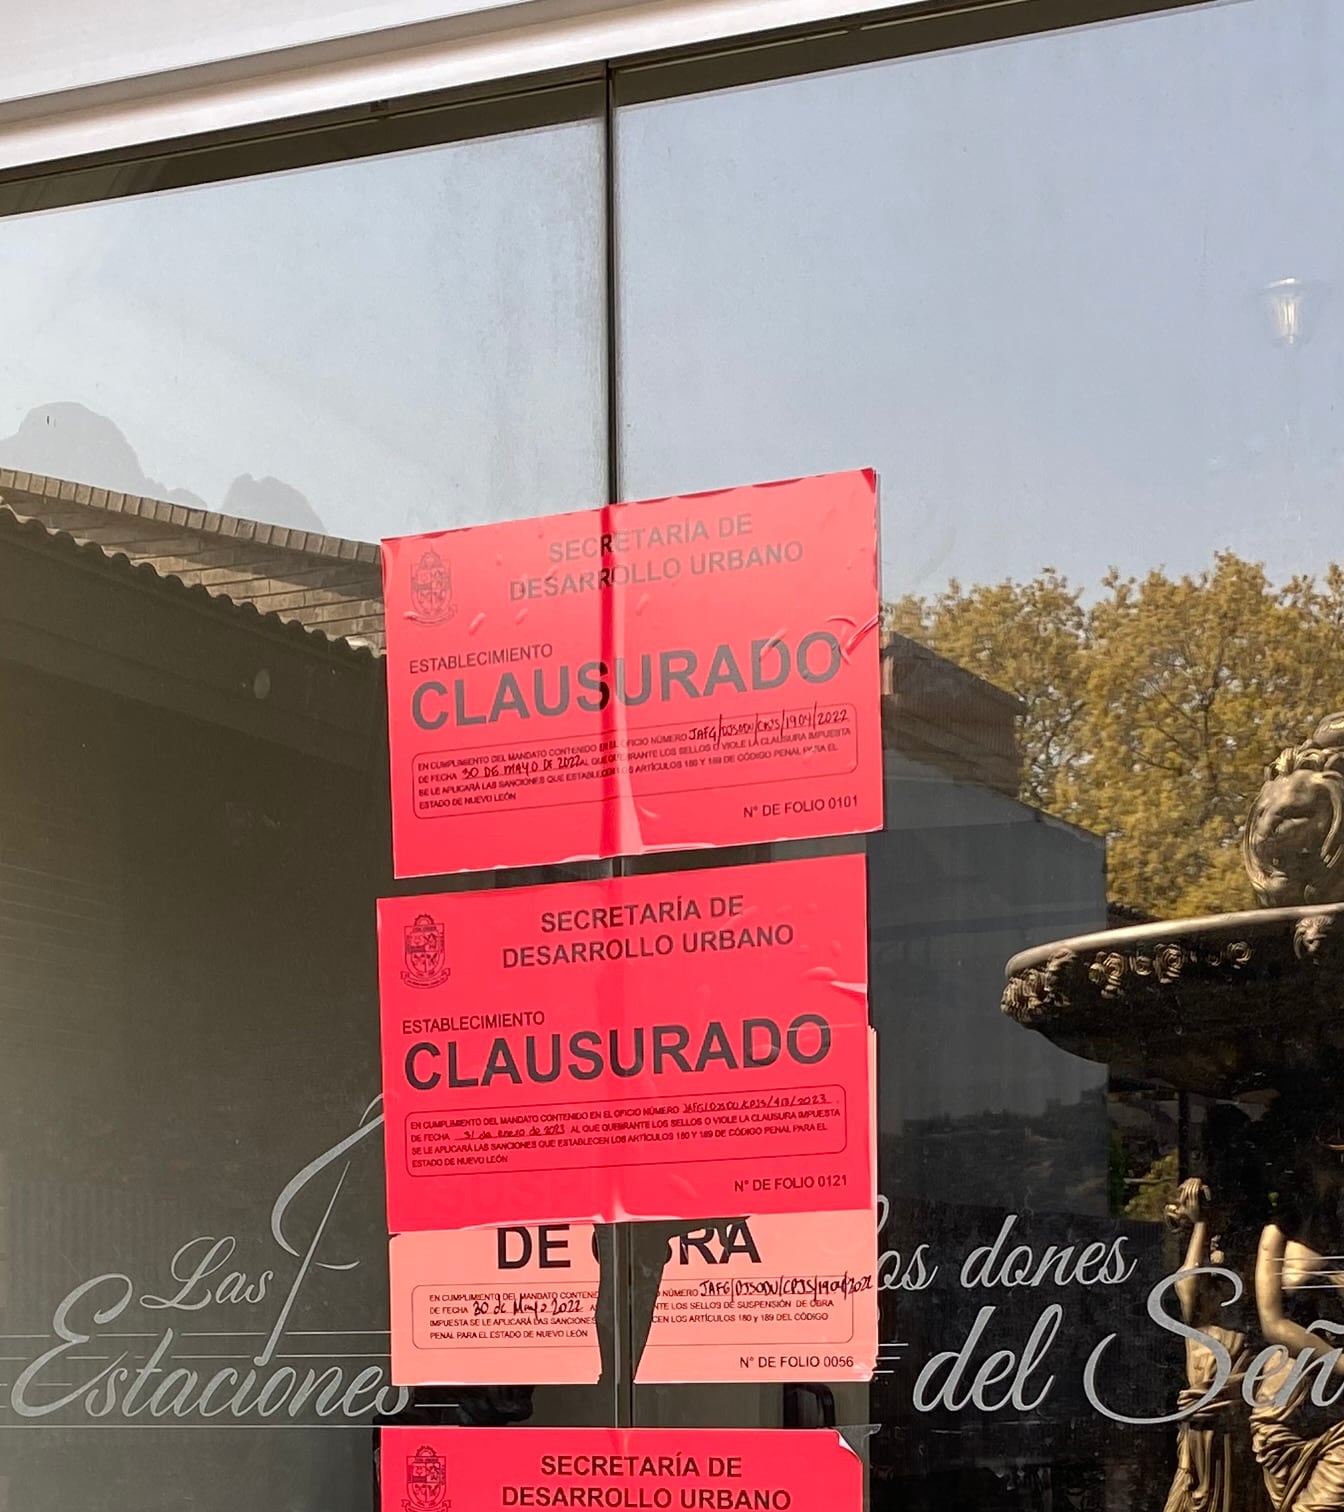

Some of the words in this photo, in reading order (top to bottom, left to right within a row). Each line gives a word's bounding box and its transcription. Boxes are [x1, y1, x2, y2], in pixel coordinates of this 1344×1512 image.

[549, 521, 709, 563] SECRETARÍA
[718, 513, 752, 538] DE
[509, 557, 681, 602] DESARROLLO
[690, 541, 803, 575] URBANO
[409, 643, 553, 674] ESTABLECIMIENTO
[411, 631, 842, 731] CLAUSURADO
[762, 803, 780, 817] DE
[784, 798, 825, 814] FOLIO
[827, 794, 857, 810] 0101
[541, 897, 701, 933] SECRETARÍA
[709, 895, 744, 918] DE
[502, 934, 674, 968] DESARROLLO
[682, 924, 793, 953] URBANO
[402, 1010, 545, 1034] ESTABLECIMIENTO
[404, 1013, 831, 1091] CLAUSURADO
[752, 1178, 771, 1191] DE
[774, 1175, 815, 1190] FOLIO
[817, 1174, 847, 1187] 0121
[497, 1224, 571, 1269] DE
[960, 1214, 1138, 1289] dones
[139, 1236, 274, 1310] Las
[662, 1287, 698, 1297] NÚMERO
[796, 1299, 808, 1307] DE
[11, 1273, 410, 1418] Estaciones
[758, 1356, 776, 1368] DE
[780, 1356, 820, 1367] FOLIO
[823, 1356, 854, 1367] 0056
[912, 1303, 1064, 1413] del
[541, 1451, 700, 1476] SECRETARÍA
[708, 1457, 741, 1477] DE
[502, 1486, 672, 1508] DESARROLLO
[680, 1488, 791, 1510] URBANO
